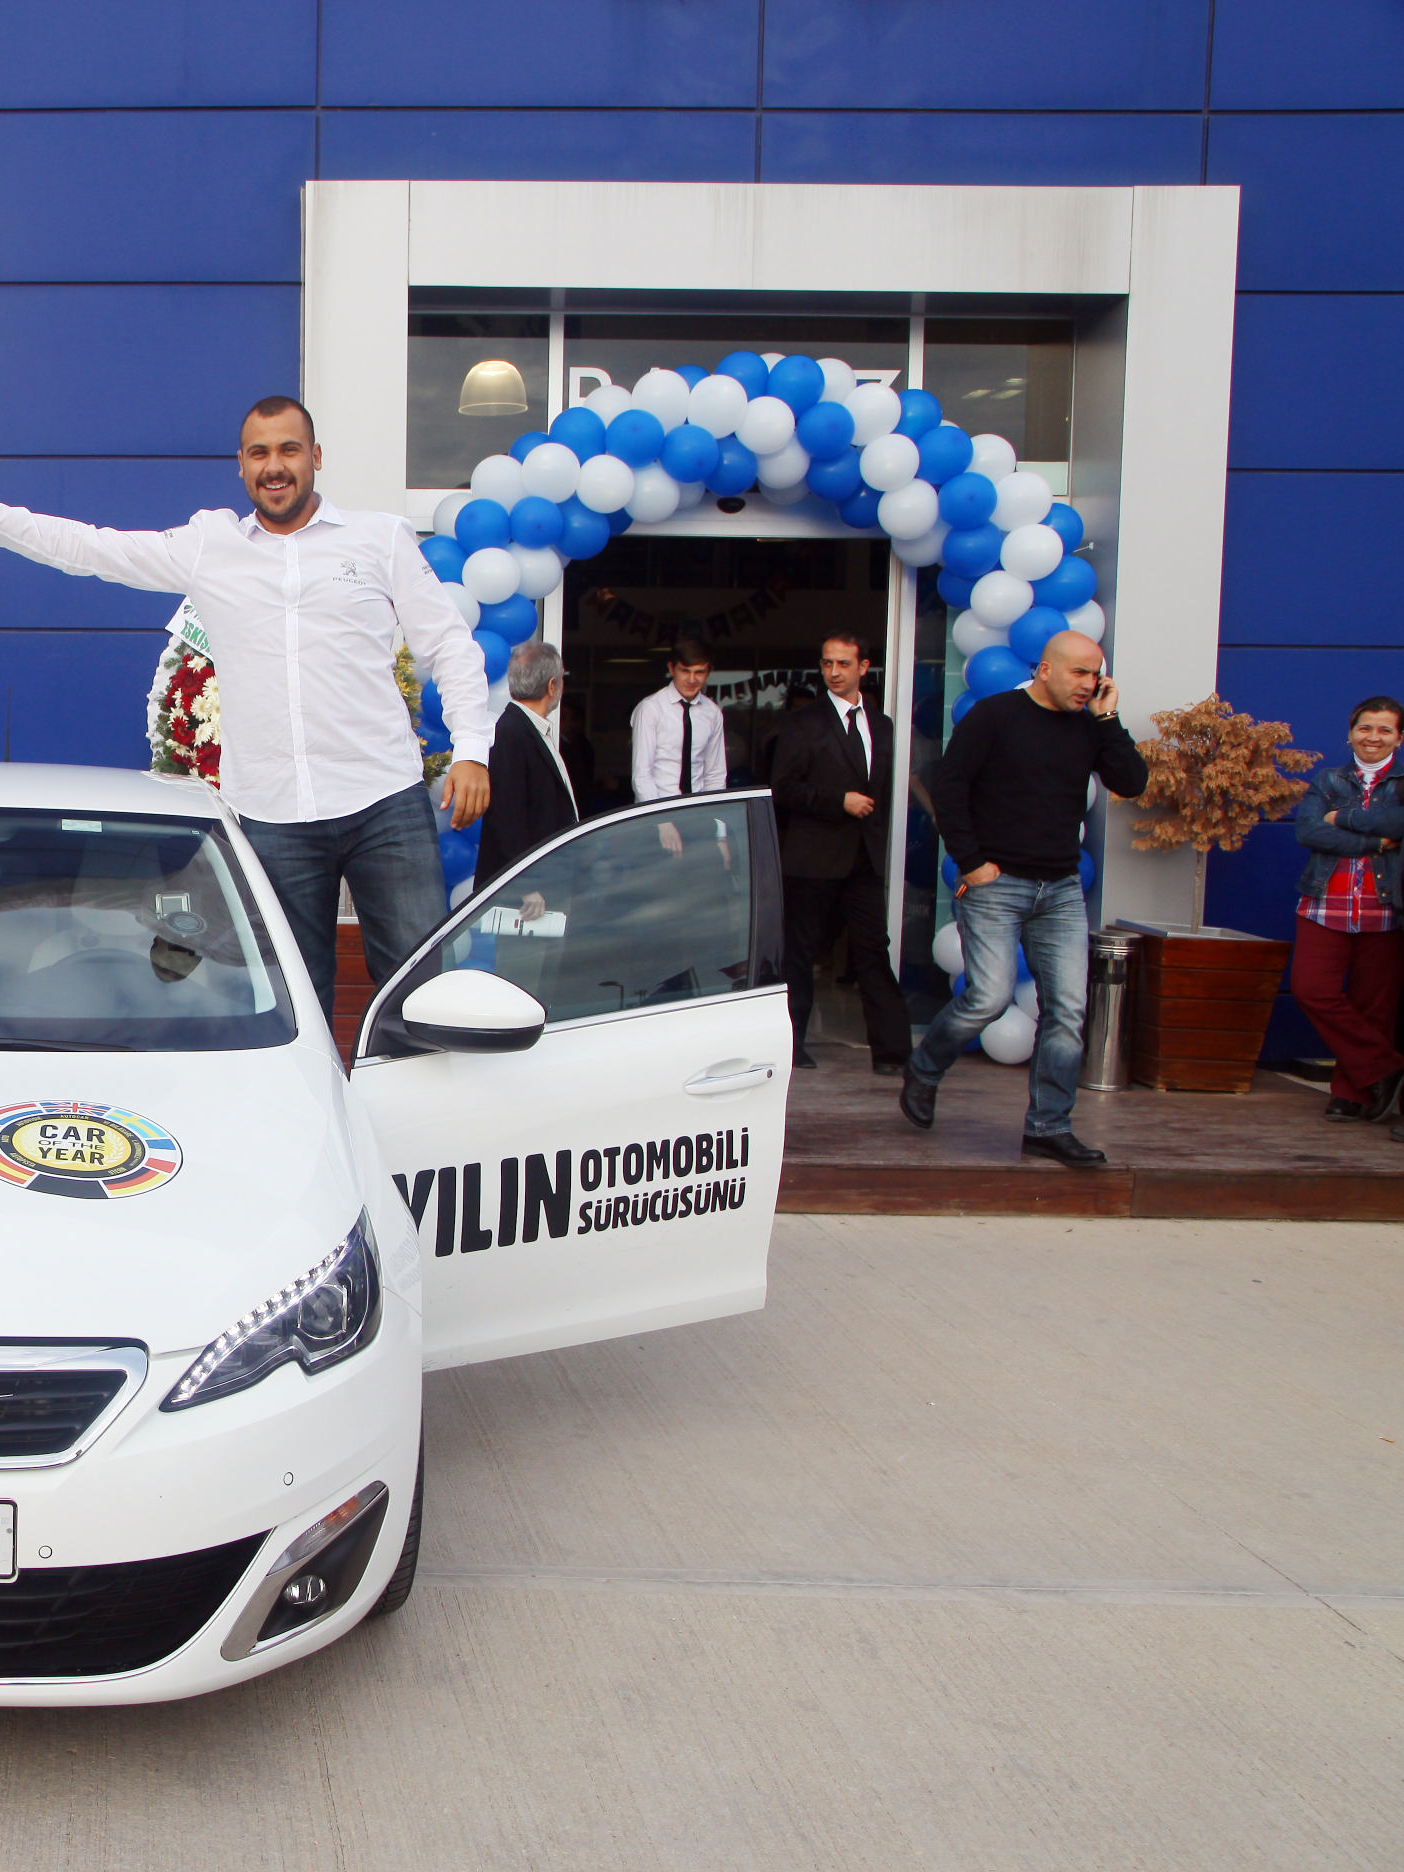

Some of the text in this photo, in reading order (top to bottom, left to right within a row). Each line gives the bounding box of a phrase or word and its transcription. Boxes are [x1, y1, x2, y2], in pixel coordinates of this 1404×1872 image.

[39, 1124, 106, 1144] CAR
[38, 1146, 104, 1166] YEAR
[68, 1141, 105, 1152] THE
[391, 1127, 749, 1257] YILIN OTOMOBİLİ
[577, 1177, 746, 1235] SÜRÜCÜSÜNÜ
